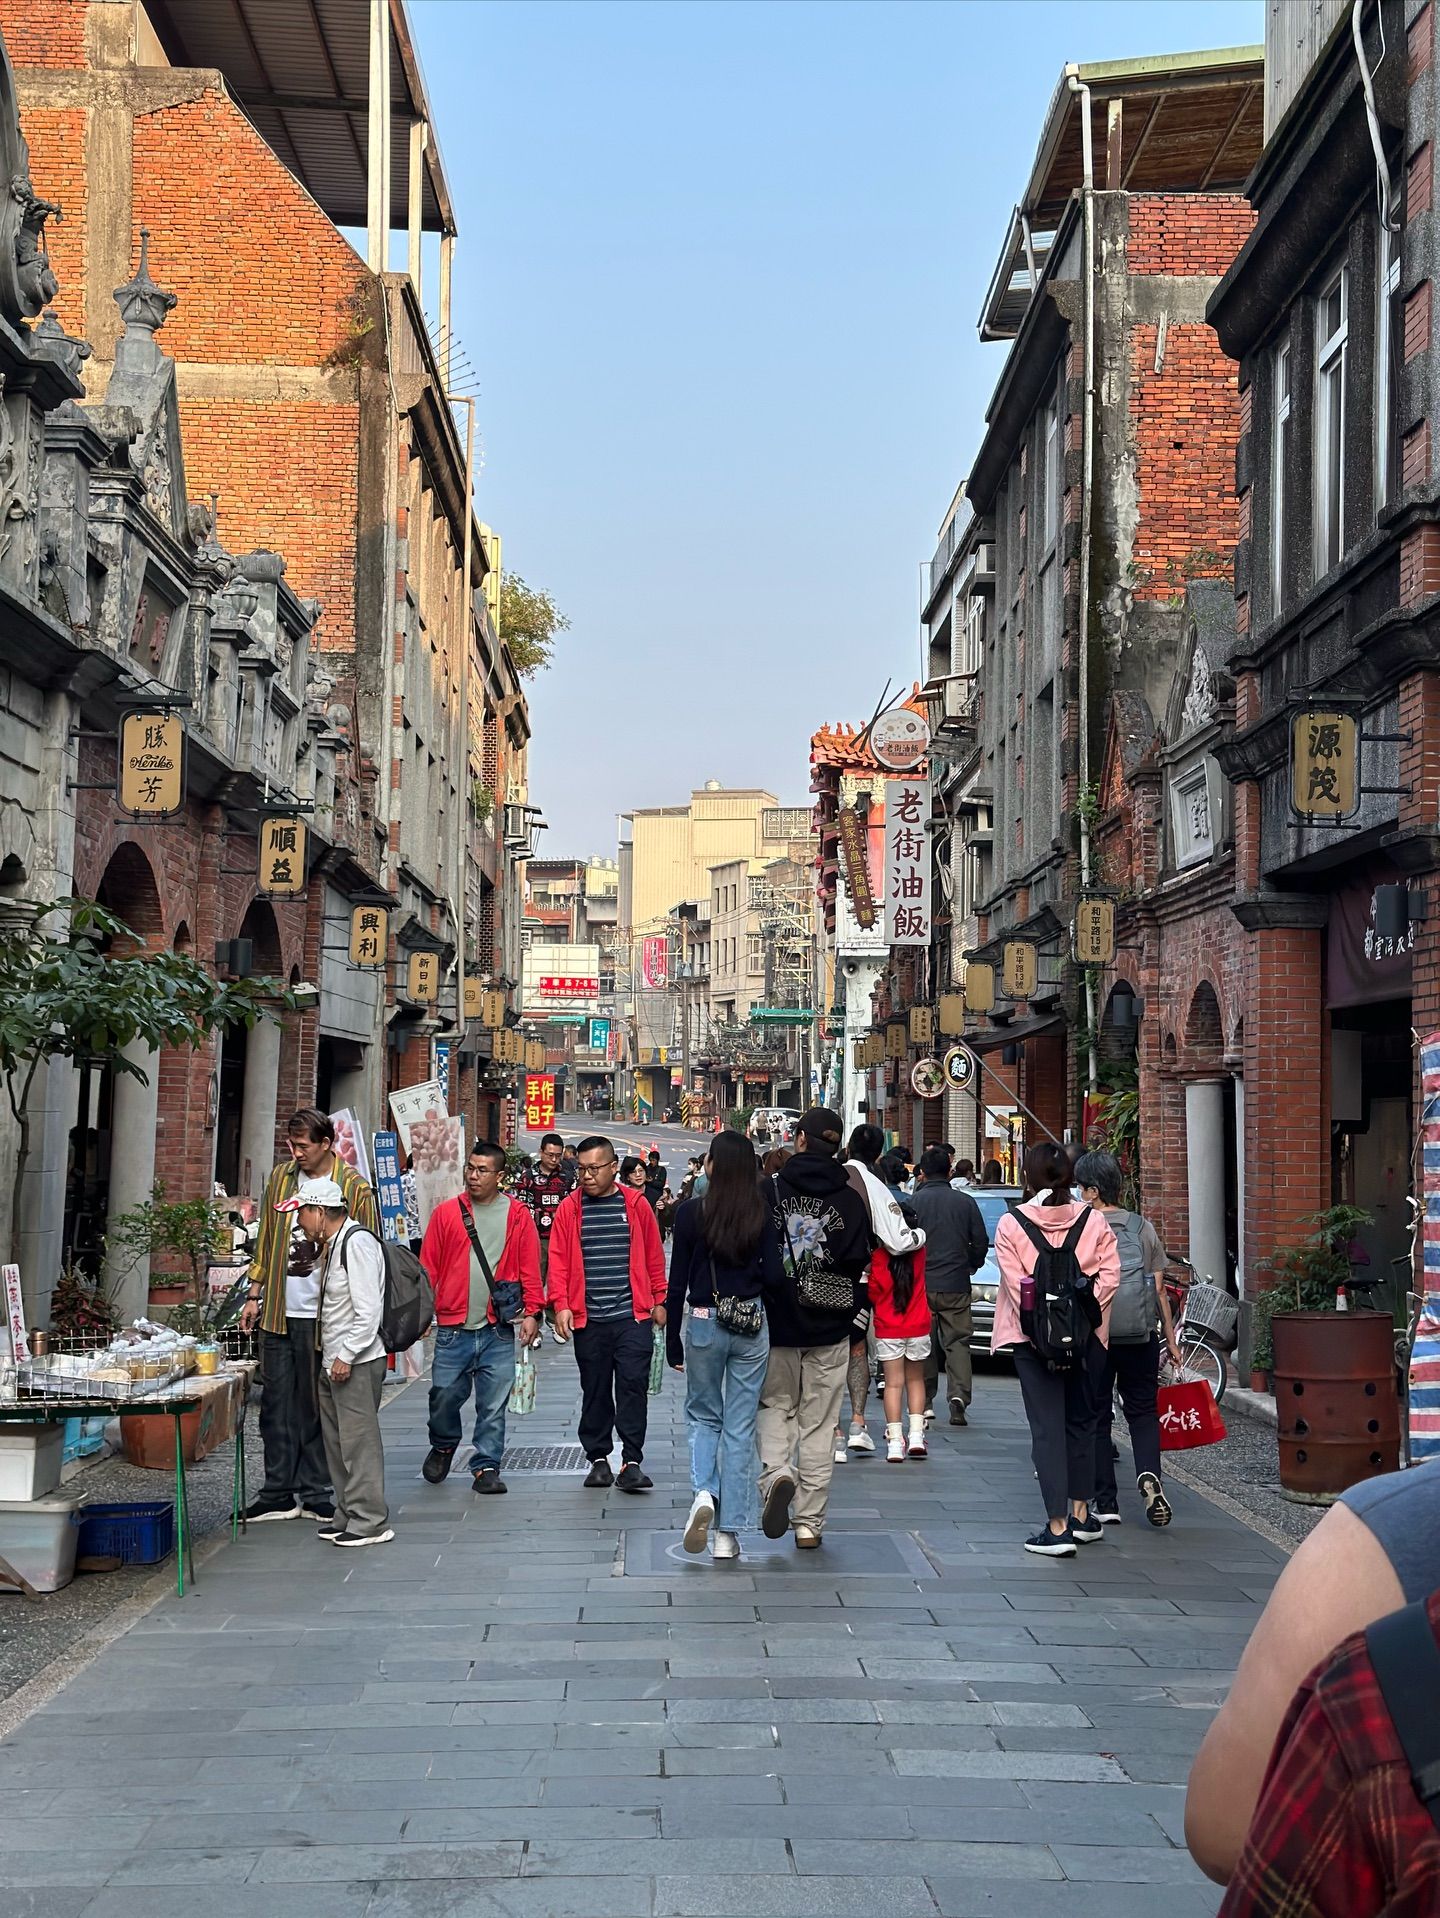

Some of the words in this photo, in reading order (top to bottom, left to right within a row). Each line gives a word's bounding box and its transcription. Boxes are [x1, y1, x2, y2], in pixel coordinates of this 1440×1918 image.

[887, 744, 919, 753] 老街油飯
[1308, 724, 1341, 803] 源茂
[138, 776, 163, 803] 芳
[269, 827, 297, 883] 順益
[891, 788, 926, 937] 老街油飯
[358, 913, 380, 958] 興利
[1091, 907, 1100, 955] 和平路15號
[417, 958, 429, 994] 新日新
[951, 1056, 967, 1078] 麵
[527, 1080, 554, 1101] 手作
[527, 1104, 554, 1125] 包子
[1159, 1404, 1202, 1430] 大溪
